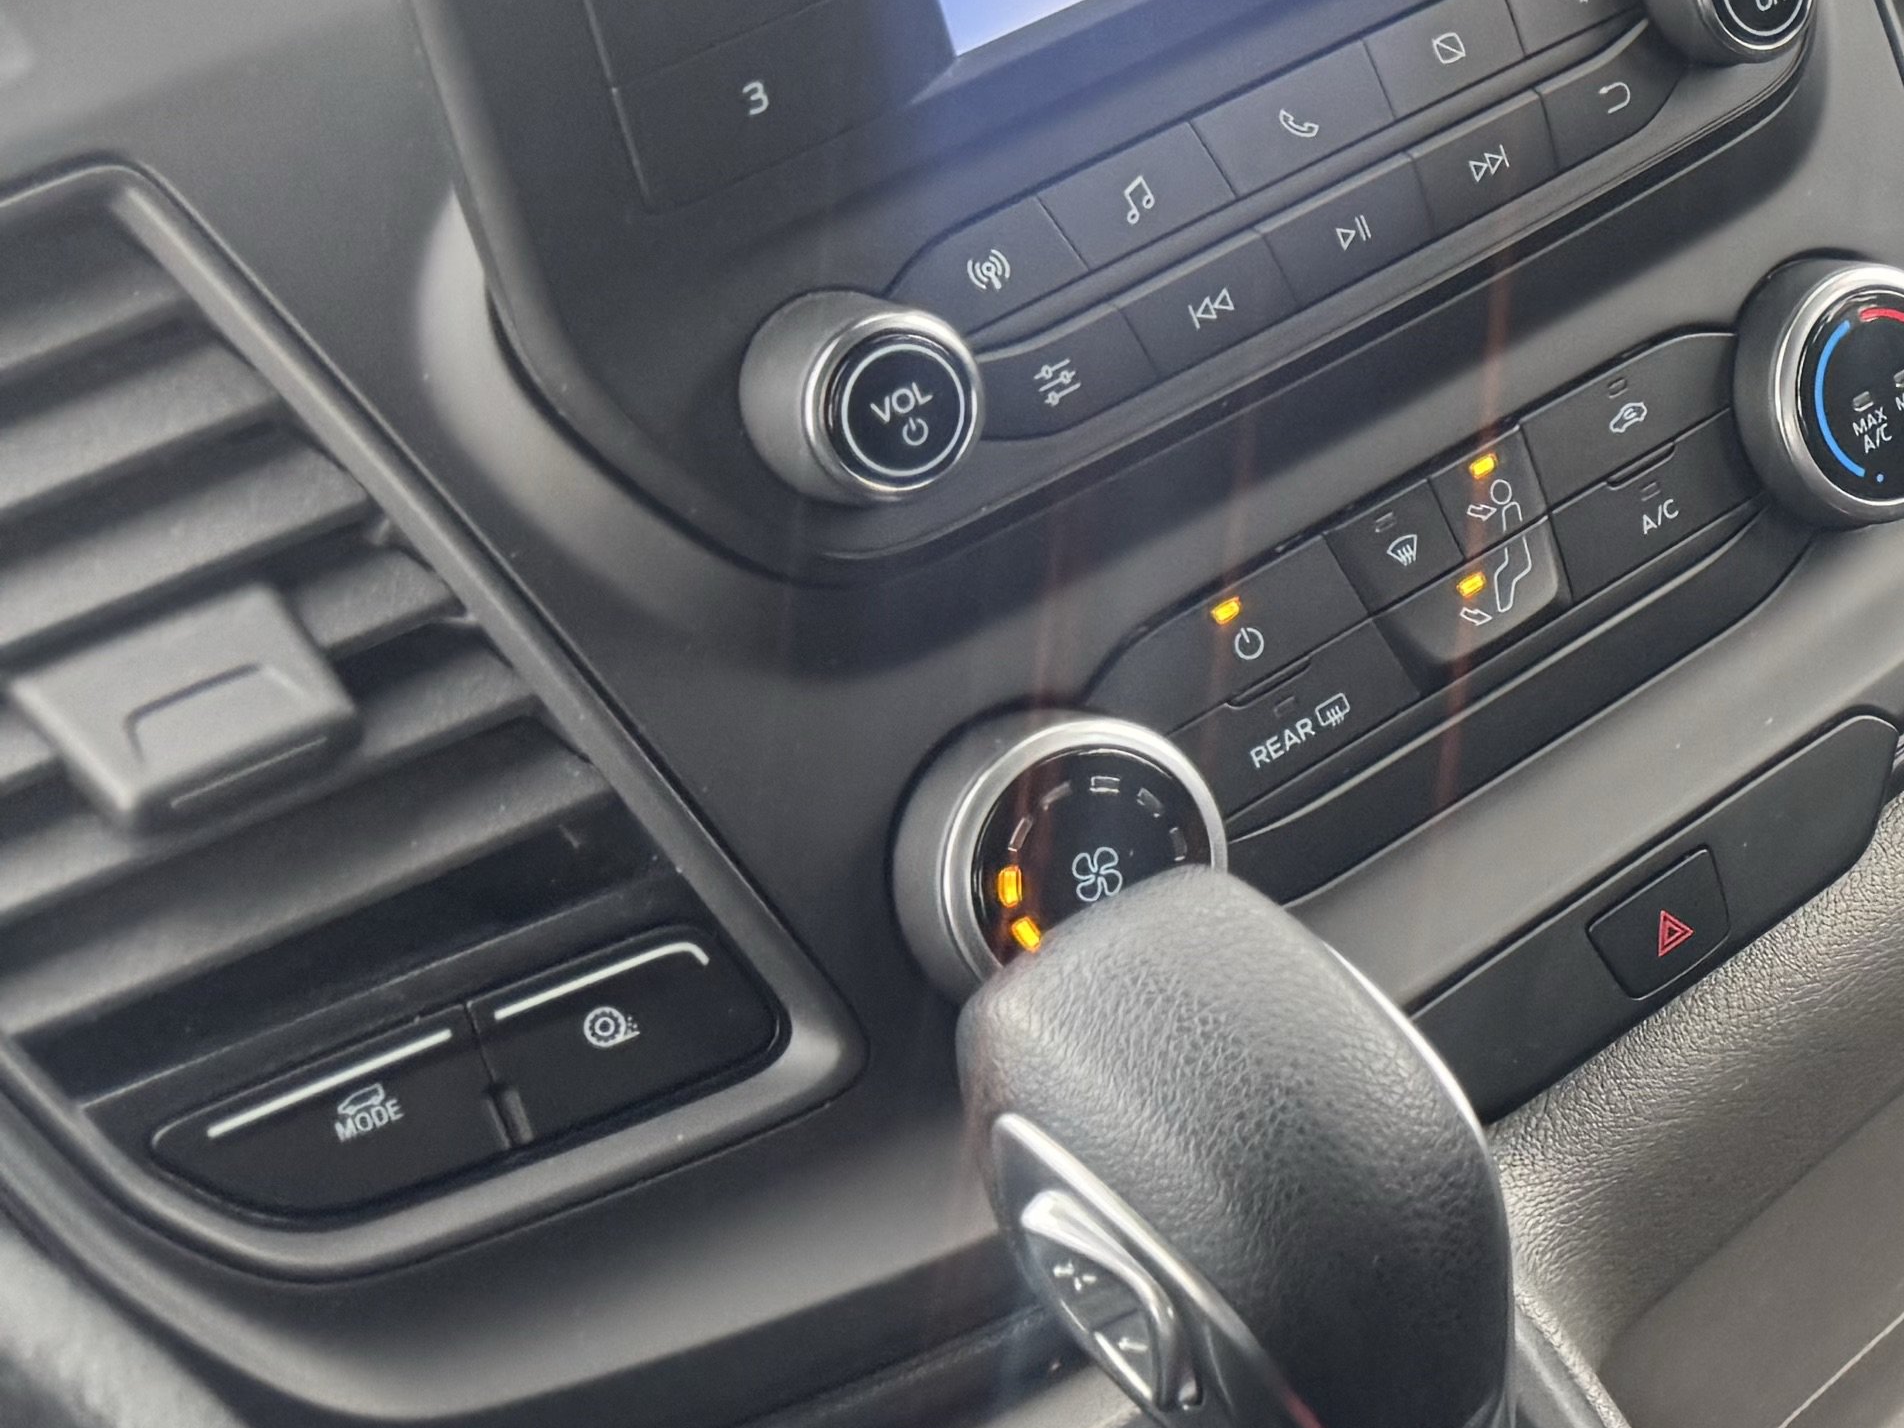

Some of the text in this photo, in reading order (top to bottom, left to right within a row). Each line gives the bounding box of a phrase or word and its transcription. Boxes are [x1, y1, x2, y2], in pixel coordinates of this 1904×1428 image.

[742, 81, 769, 115] 3
[870, 381, 933, 423] VOL
[1852, 406, 1887, 436] MAX
[1863, 423, 1892, 453] A/C
[1642, 498, 1679, 535] A/C
[1250, 717, 1316, 768] REAR
[335, 1098, 404, 1143] MODE
